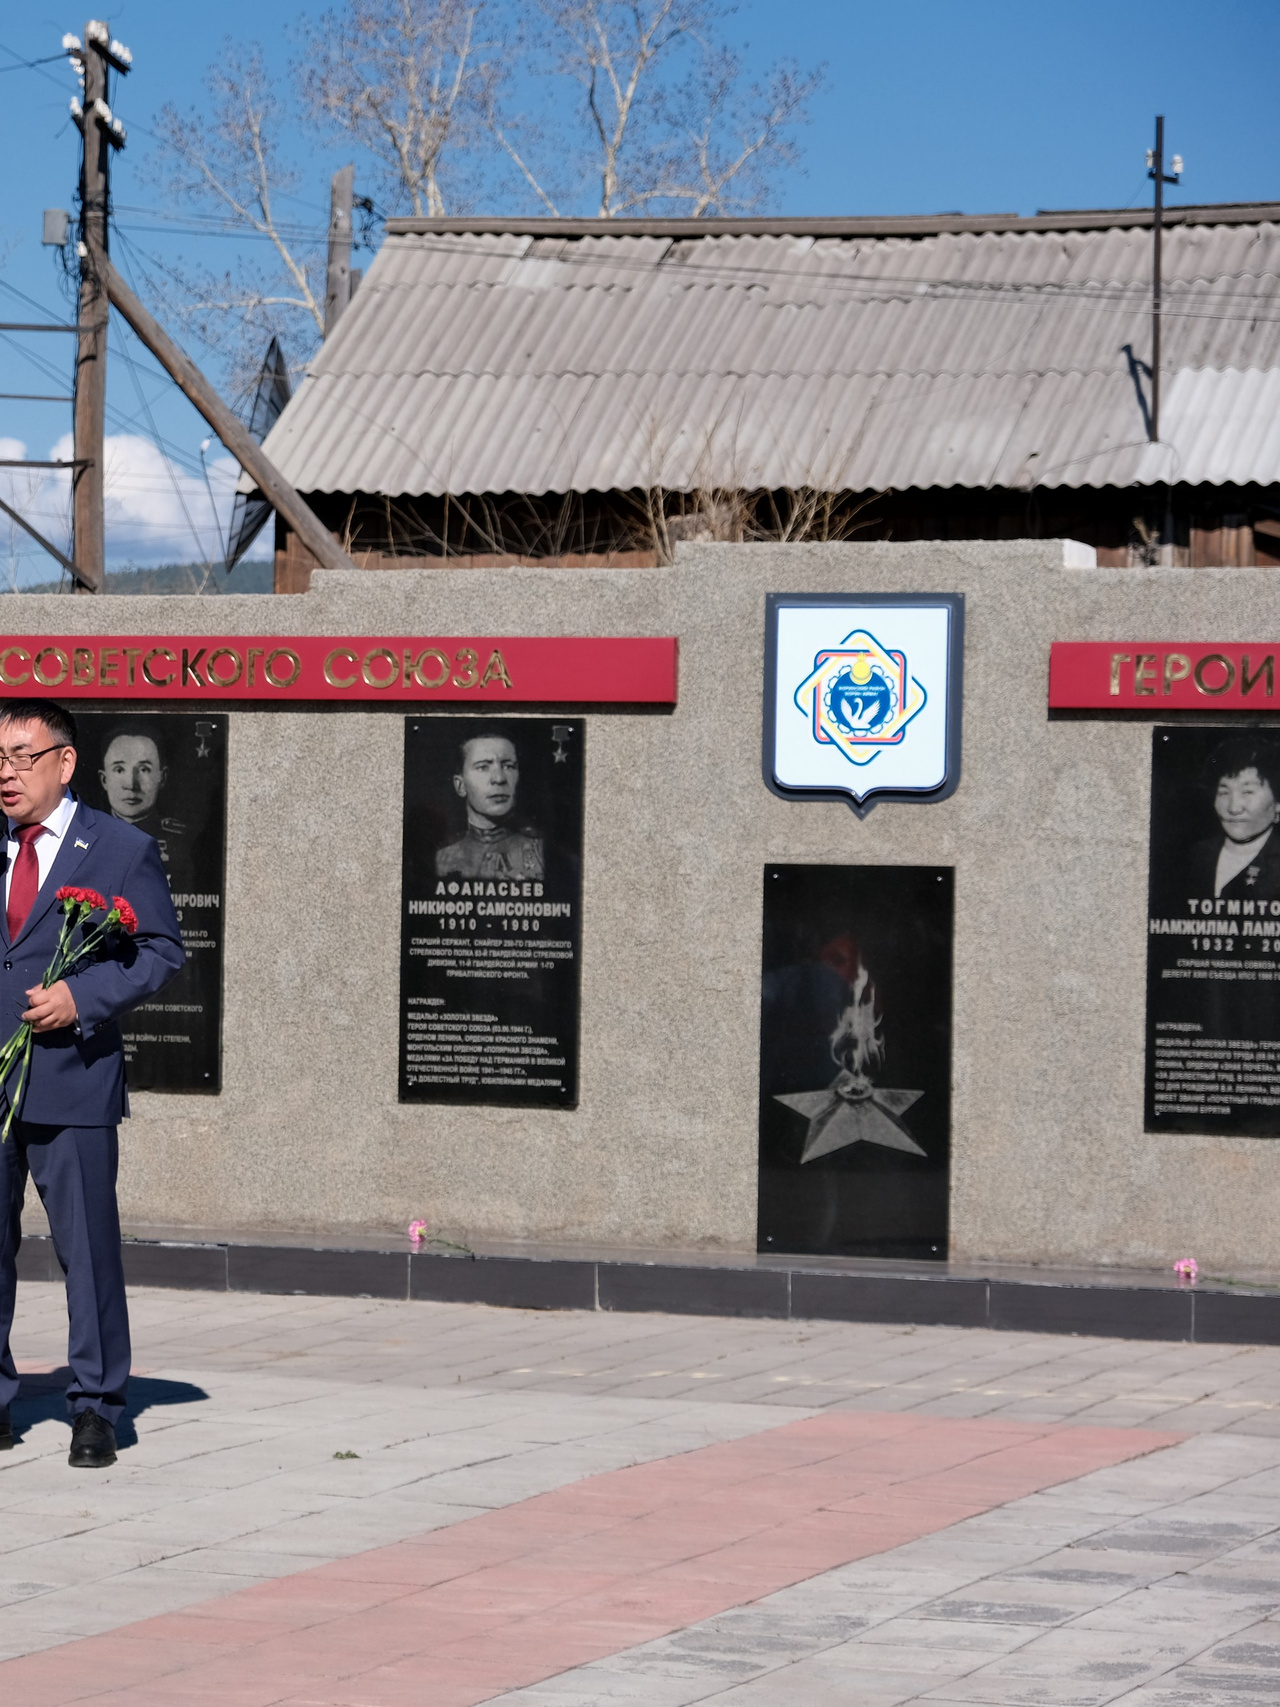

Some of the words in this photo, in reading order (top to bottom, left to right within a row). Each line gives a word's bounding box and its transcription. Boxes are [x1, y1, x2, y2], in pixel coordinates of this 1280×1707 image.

[322, 647, 514, 689] СОЮЗА
[1110, 653, 1275, 696] ГЕРОИ
[436, 882, 544, 896] АФАНАСЬЕВ
[409, 900, 473, 915] НИКИФОР
[477, 902, 570, 917] САМСОНОВИЧ
[440, 918, 476, 930] 1910
[502, 919, 540, 931] 1980
[1150, 919, 1239, 935] НАМЖИЛМА
[1192, 937, 1234, 951] 1932
